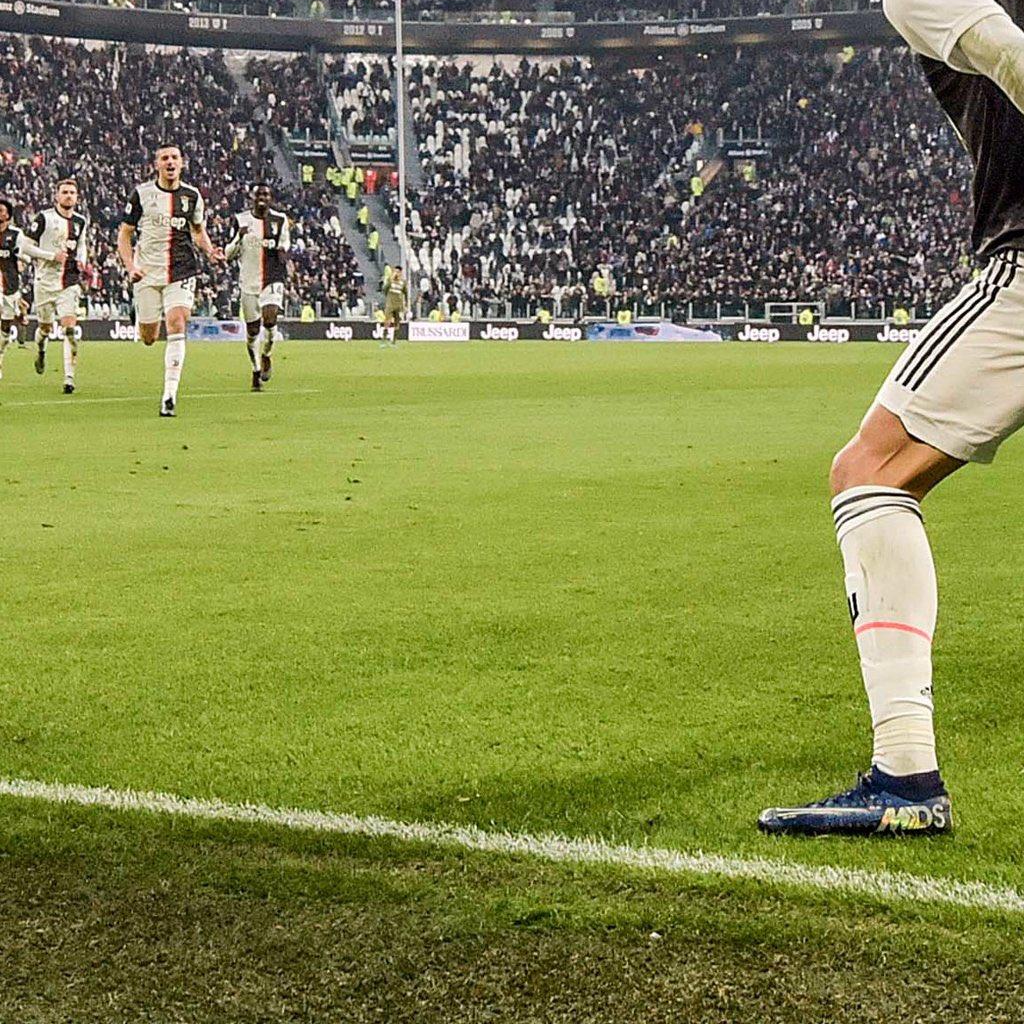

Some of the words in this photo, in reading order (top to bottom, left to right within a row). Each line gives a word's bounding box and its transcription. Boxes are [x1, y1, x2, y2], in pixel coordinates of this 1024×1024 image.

[26, 3, 60, 17] Stadium
[643, 24, 676, 36] Allianz
[690, 24, 726, 34] Stadium
[326, 322, 353, 341] Jeep
[411, 325, 468, 338] TRUSSARDI
[480, 323, 519, 342] Jeep
[543, 323, 582, 342] Jeep
[738, 324, 780, 343] Jeep
[807, 324, 849, 343] Jeep
